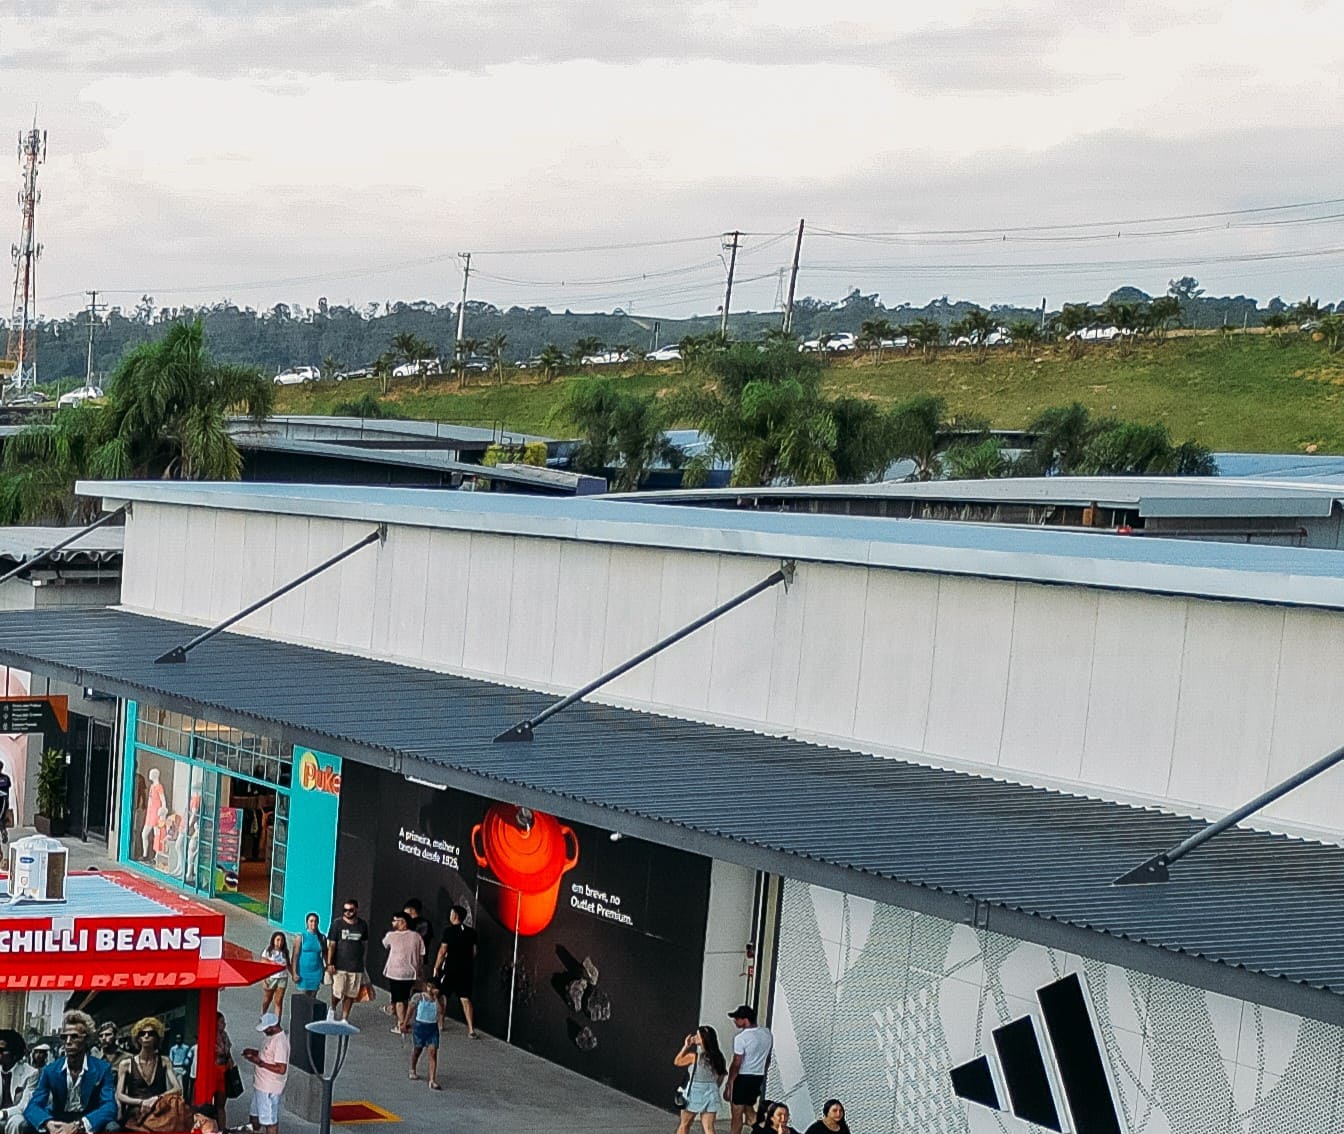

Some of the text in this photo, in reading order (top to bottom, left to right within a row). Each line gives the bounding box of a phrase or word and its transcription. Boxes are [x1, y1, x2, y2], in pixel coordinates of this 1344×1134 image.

[570, 896, 595, 914] Outlet
[610, 895, 621, 906] no
[95, 927, 201, 951] BEANS
